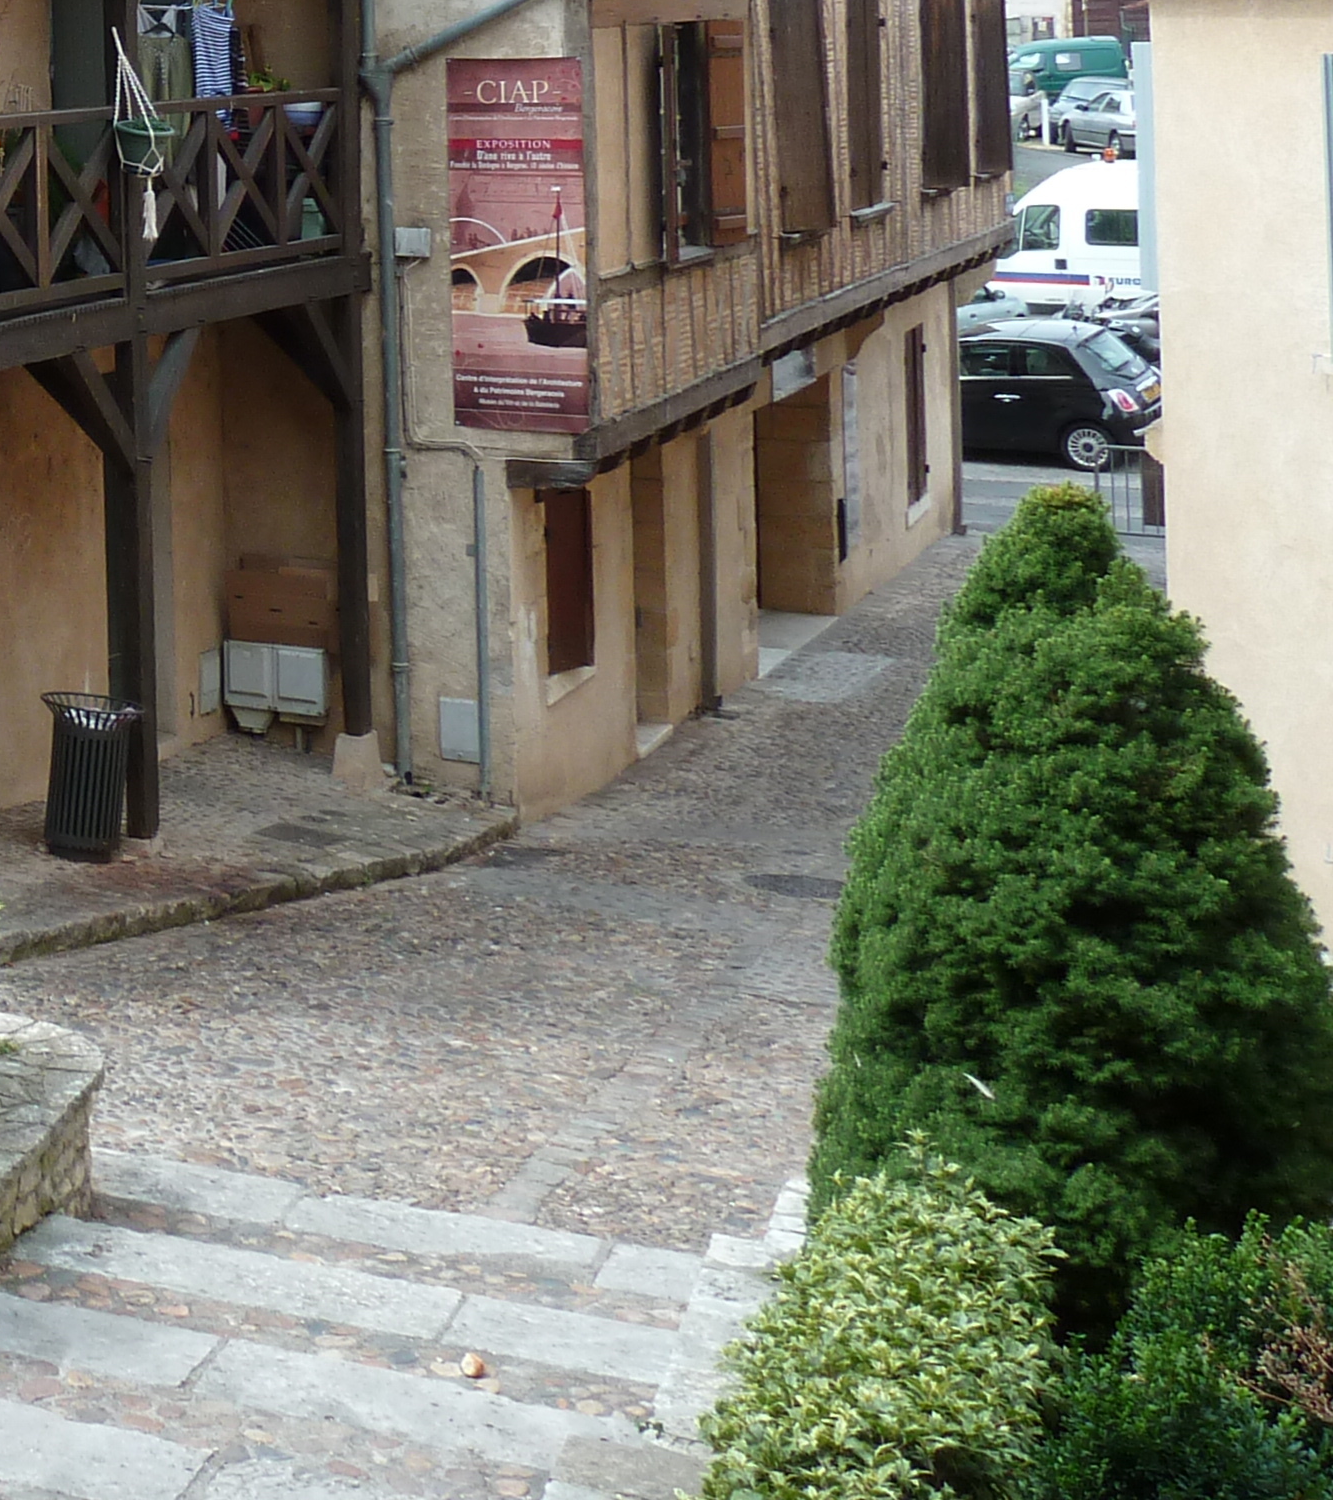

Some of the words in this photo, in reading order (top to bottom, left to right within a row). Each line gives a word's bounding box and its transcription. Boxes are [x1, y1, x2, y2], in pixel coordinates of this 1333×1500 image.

[476, 139, 552, 149] EXPOSITION
[501, 152, 516, 161] rive
[526, 151, 552, 162] l'autre
